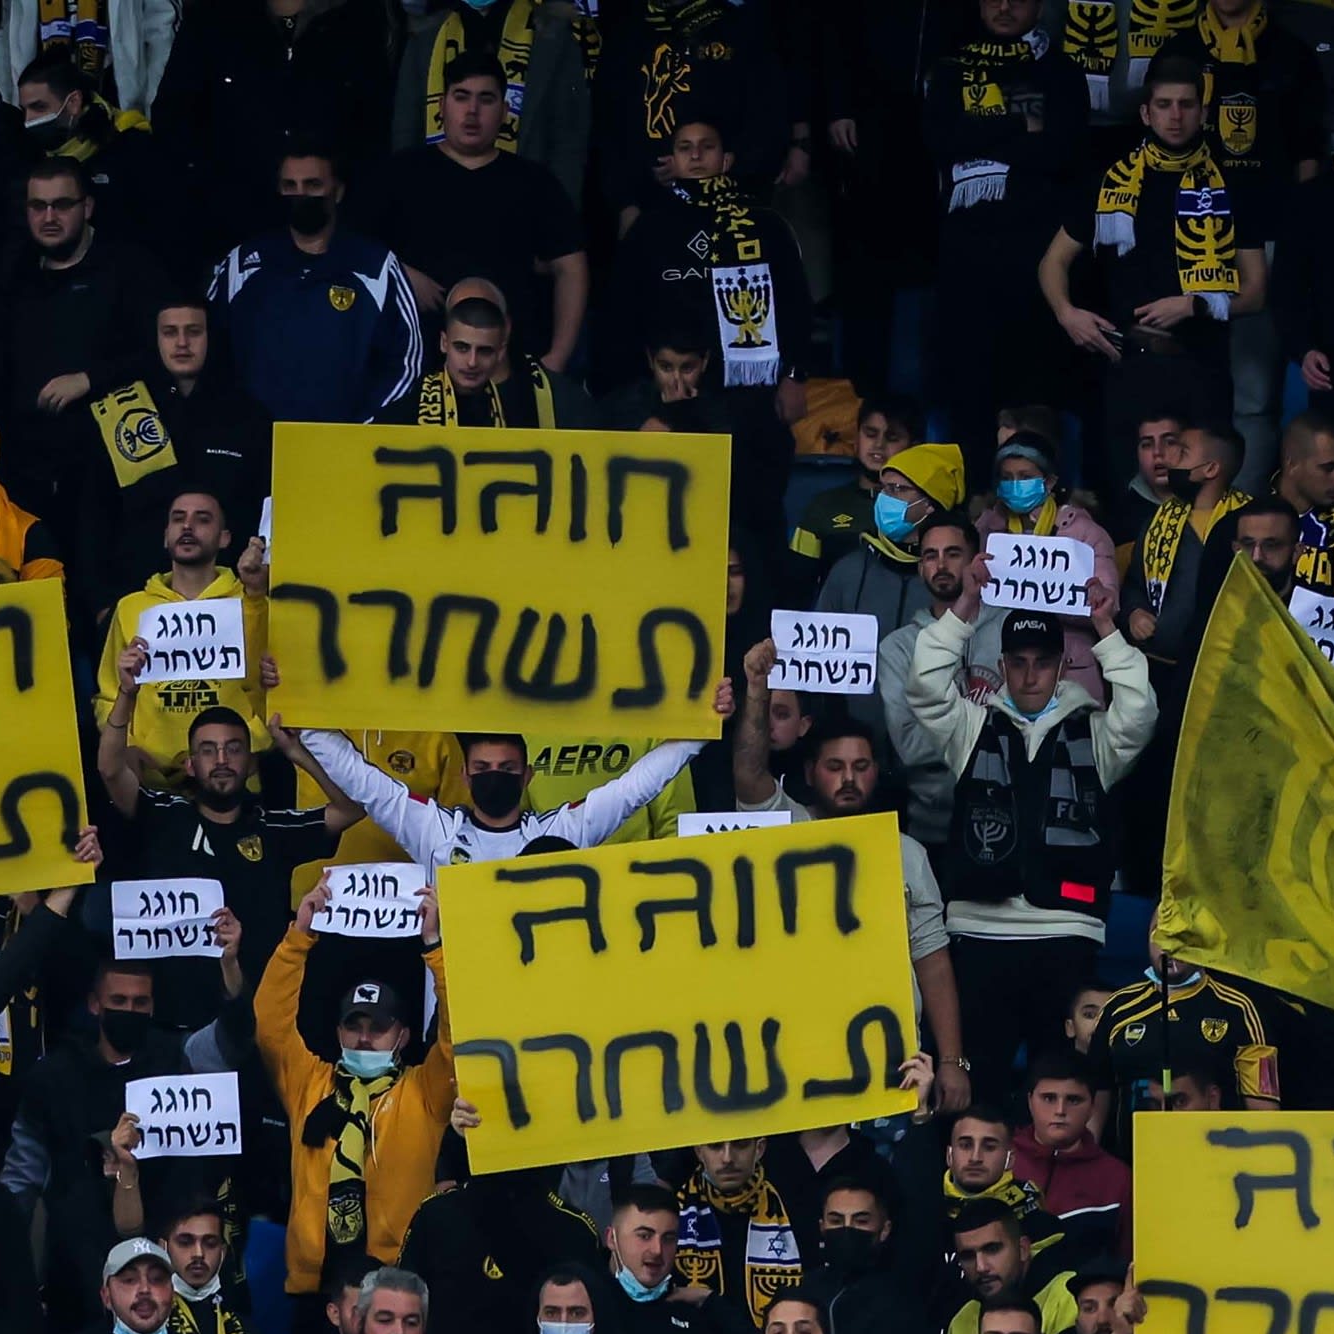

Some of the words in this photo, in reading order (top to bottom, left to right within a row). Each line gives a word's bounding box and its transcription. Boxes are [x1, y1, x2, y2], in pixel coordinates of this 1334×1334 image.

[374, 444, 691, 551] חוגג
[1010, 545, 1070, 571] חוגג
[157, 612, 217, 639] חוגג
[792, 622, 851, 649] חוגג
[1013, 619, 1048, 633] NASA
[144, 644, 241, 672] תשחרר
[270, 583, 712, 709] תשחרר
[774, 657, 873, 685] תשחרר
[157, 690, 220, 707] ביתר
[531, 742, 630, 777] AERO
[344, 873, 400, 898] חוגג
[139, 891, 200, 918] חוגג
[323, 904, 421, 930] תשחרר
[497, 846, 861, 966] חוגג
[117, 924, 217, 950] תשחרר
[151, 1087, 212, 1114] חוגג
